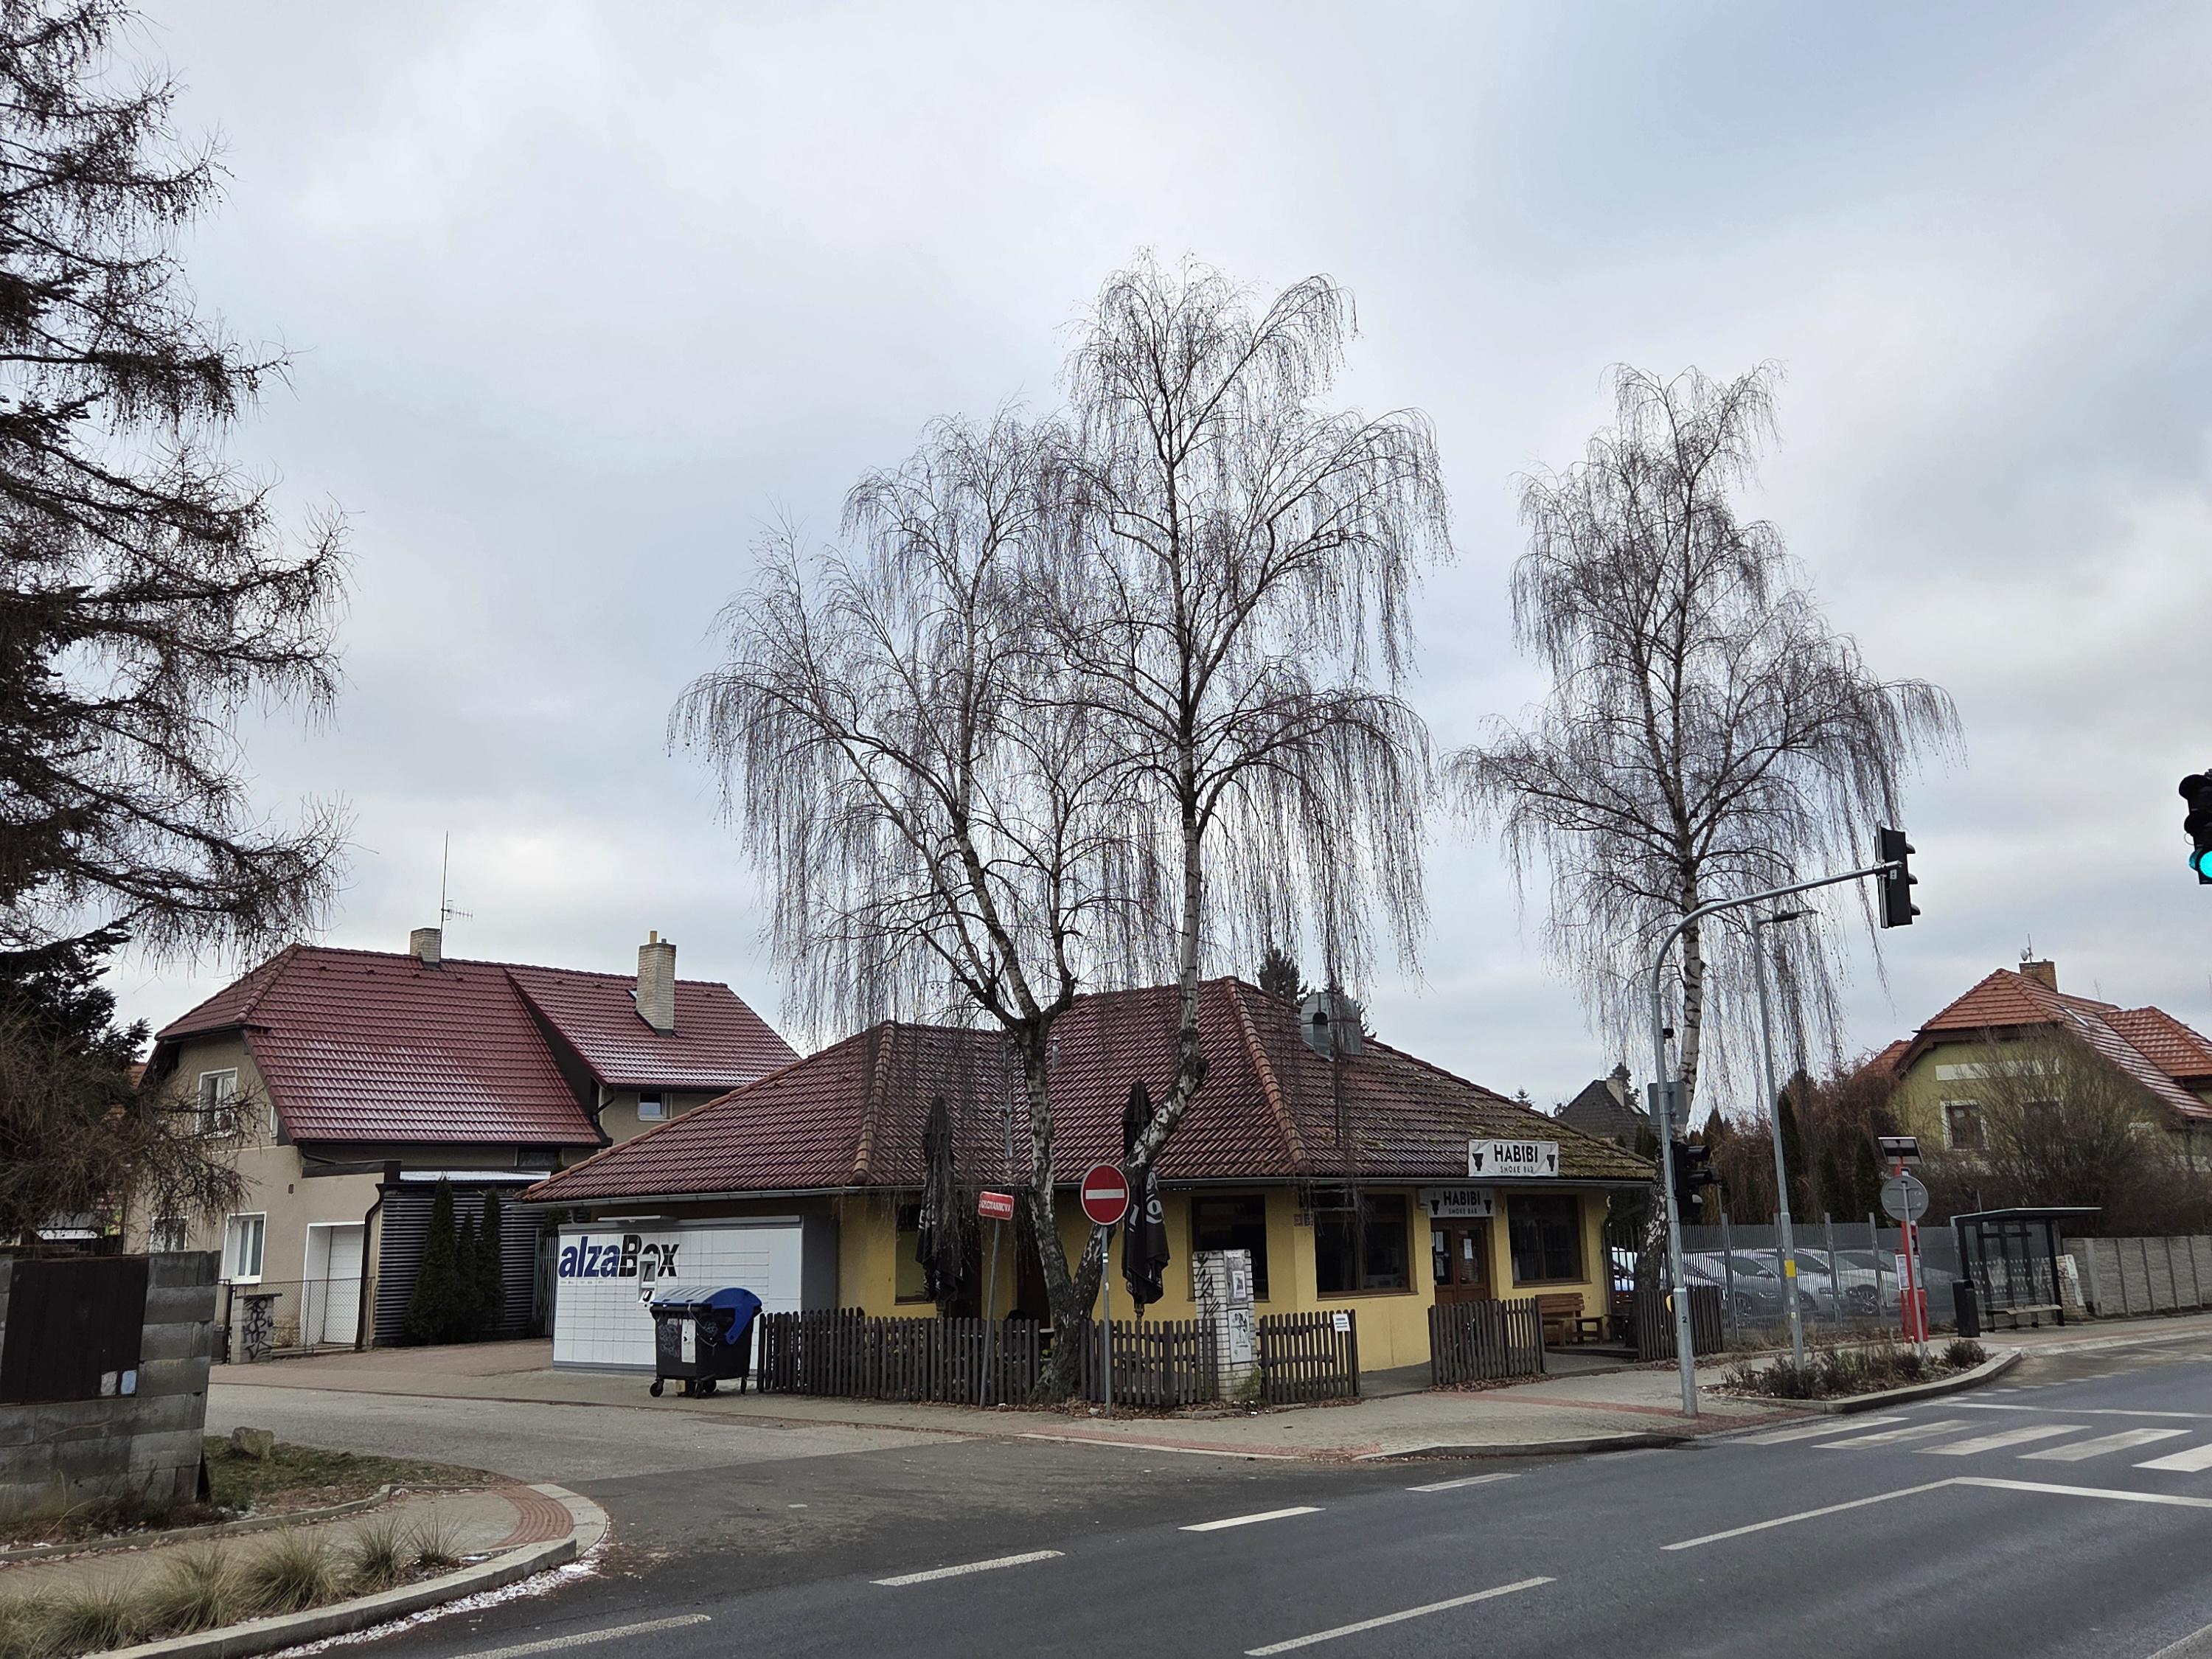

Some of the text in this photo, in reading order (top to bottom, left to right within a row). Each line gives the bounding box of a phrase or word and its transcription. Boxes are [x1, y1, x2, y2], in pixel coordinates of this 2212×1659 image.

[1494, 1144, 1538, 1163] HABIBI
[1500, 1166, 1520, 1174] SMOKE
[1443, 1191, 1481, 1206] HABIBI
